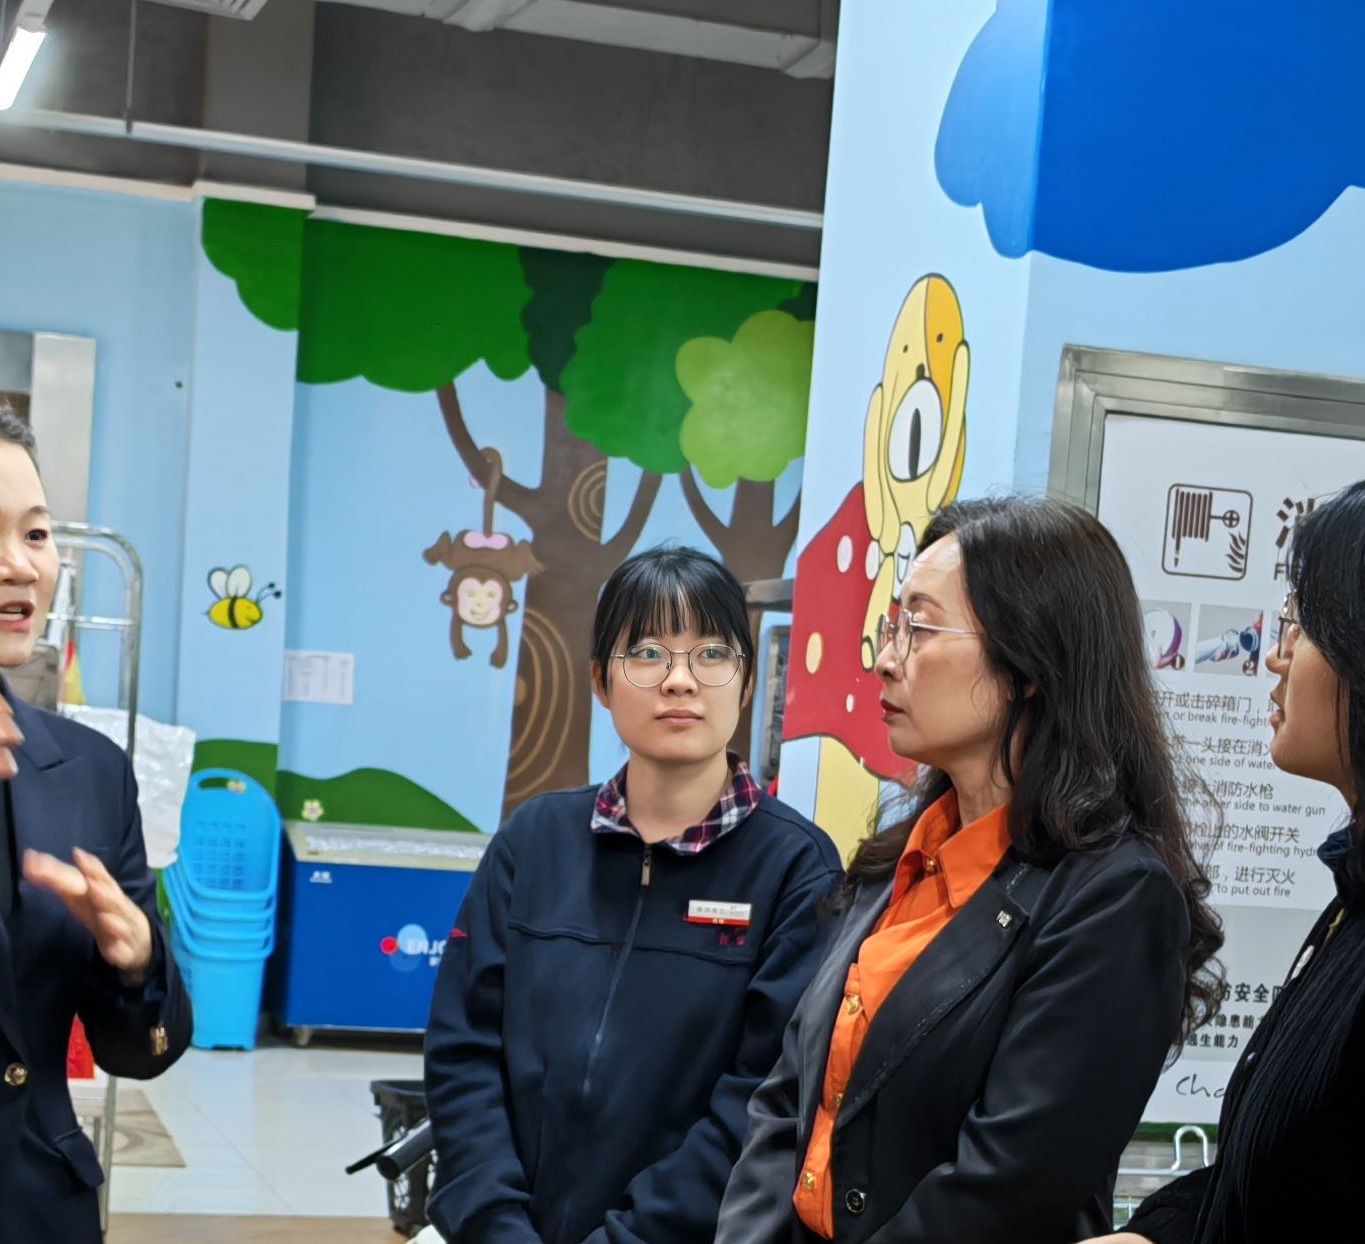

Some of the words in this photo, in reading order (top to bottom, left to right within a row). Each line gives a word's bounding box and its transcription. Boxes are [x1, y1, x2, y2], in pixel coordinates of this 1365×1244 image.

[1173, 711, 1185, 721] or
[1188, 711, 1217, 724] break
[1209, 754, 1231, 767] side
[1234, 756, 1246, 768] of
[1234, 799, 1255, 812] side
[1259, 801, 1270, 812] to
[1273, 804, 1302, 815] water
[1305, 806, 1326, 817] gun
[1227, 841, 1290, 857] fire-fighting
[1217, 883, 1228, 894] to
[1231, 884, 1249, 897] put
[1252, 885, 1270, 896] out
[1273, 886, 1291, 898] fire
